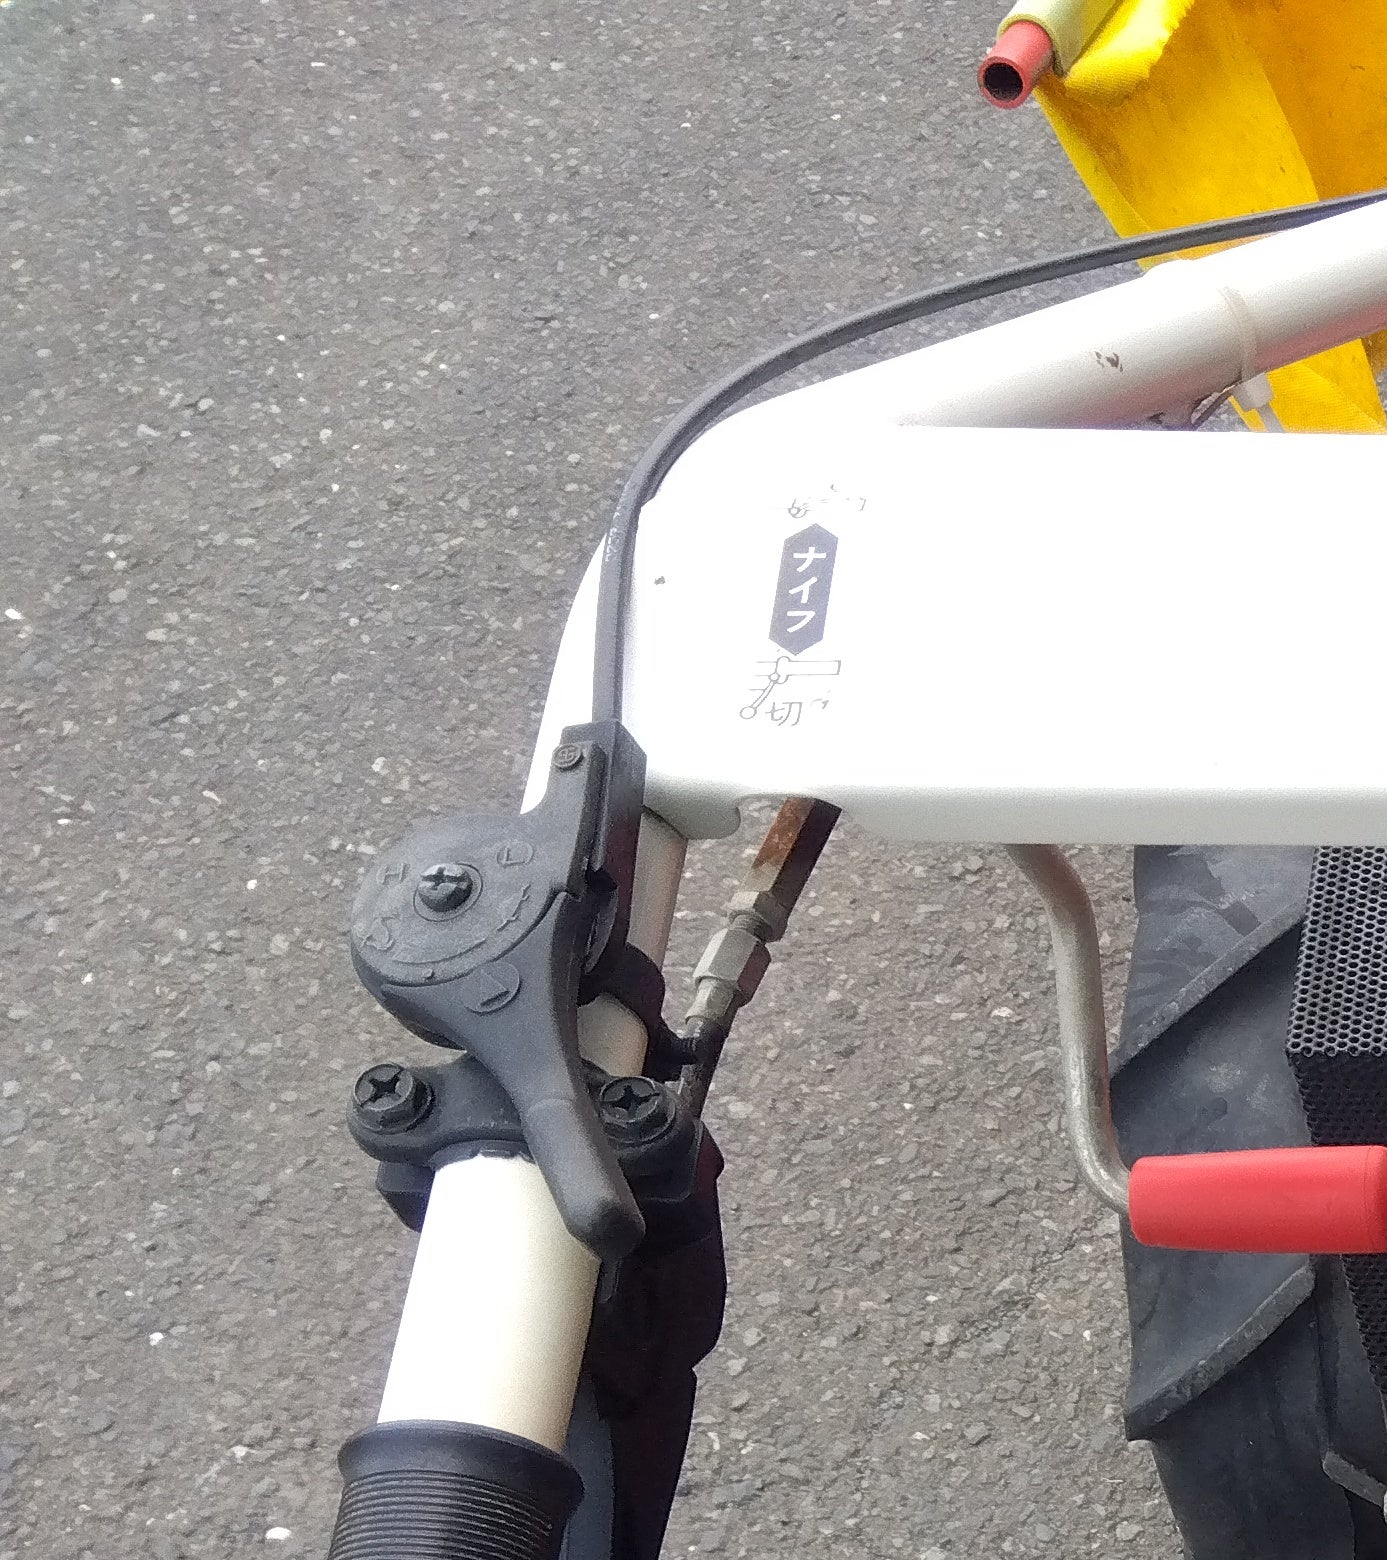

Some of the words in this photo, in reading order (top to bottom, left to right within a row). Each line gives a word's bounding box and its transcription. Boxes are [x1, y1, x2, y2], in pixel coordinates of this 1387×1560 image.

[787, 546, 827, 633] ナイフ
[765, 702, 803, 726] 切
